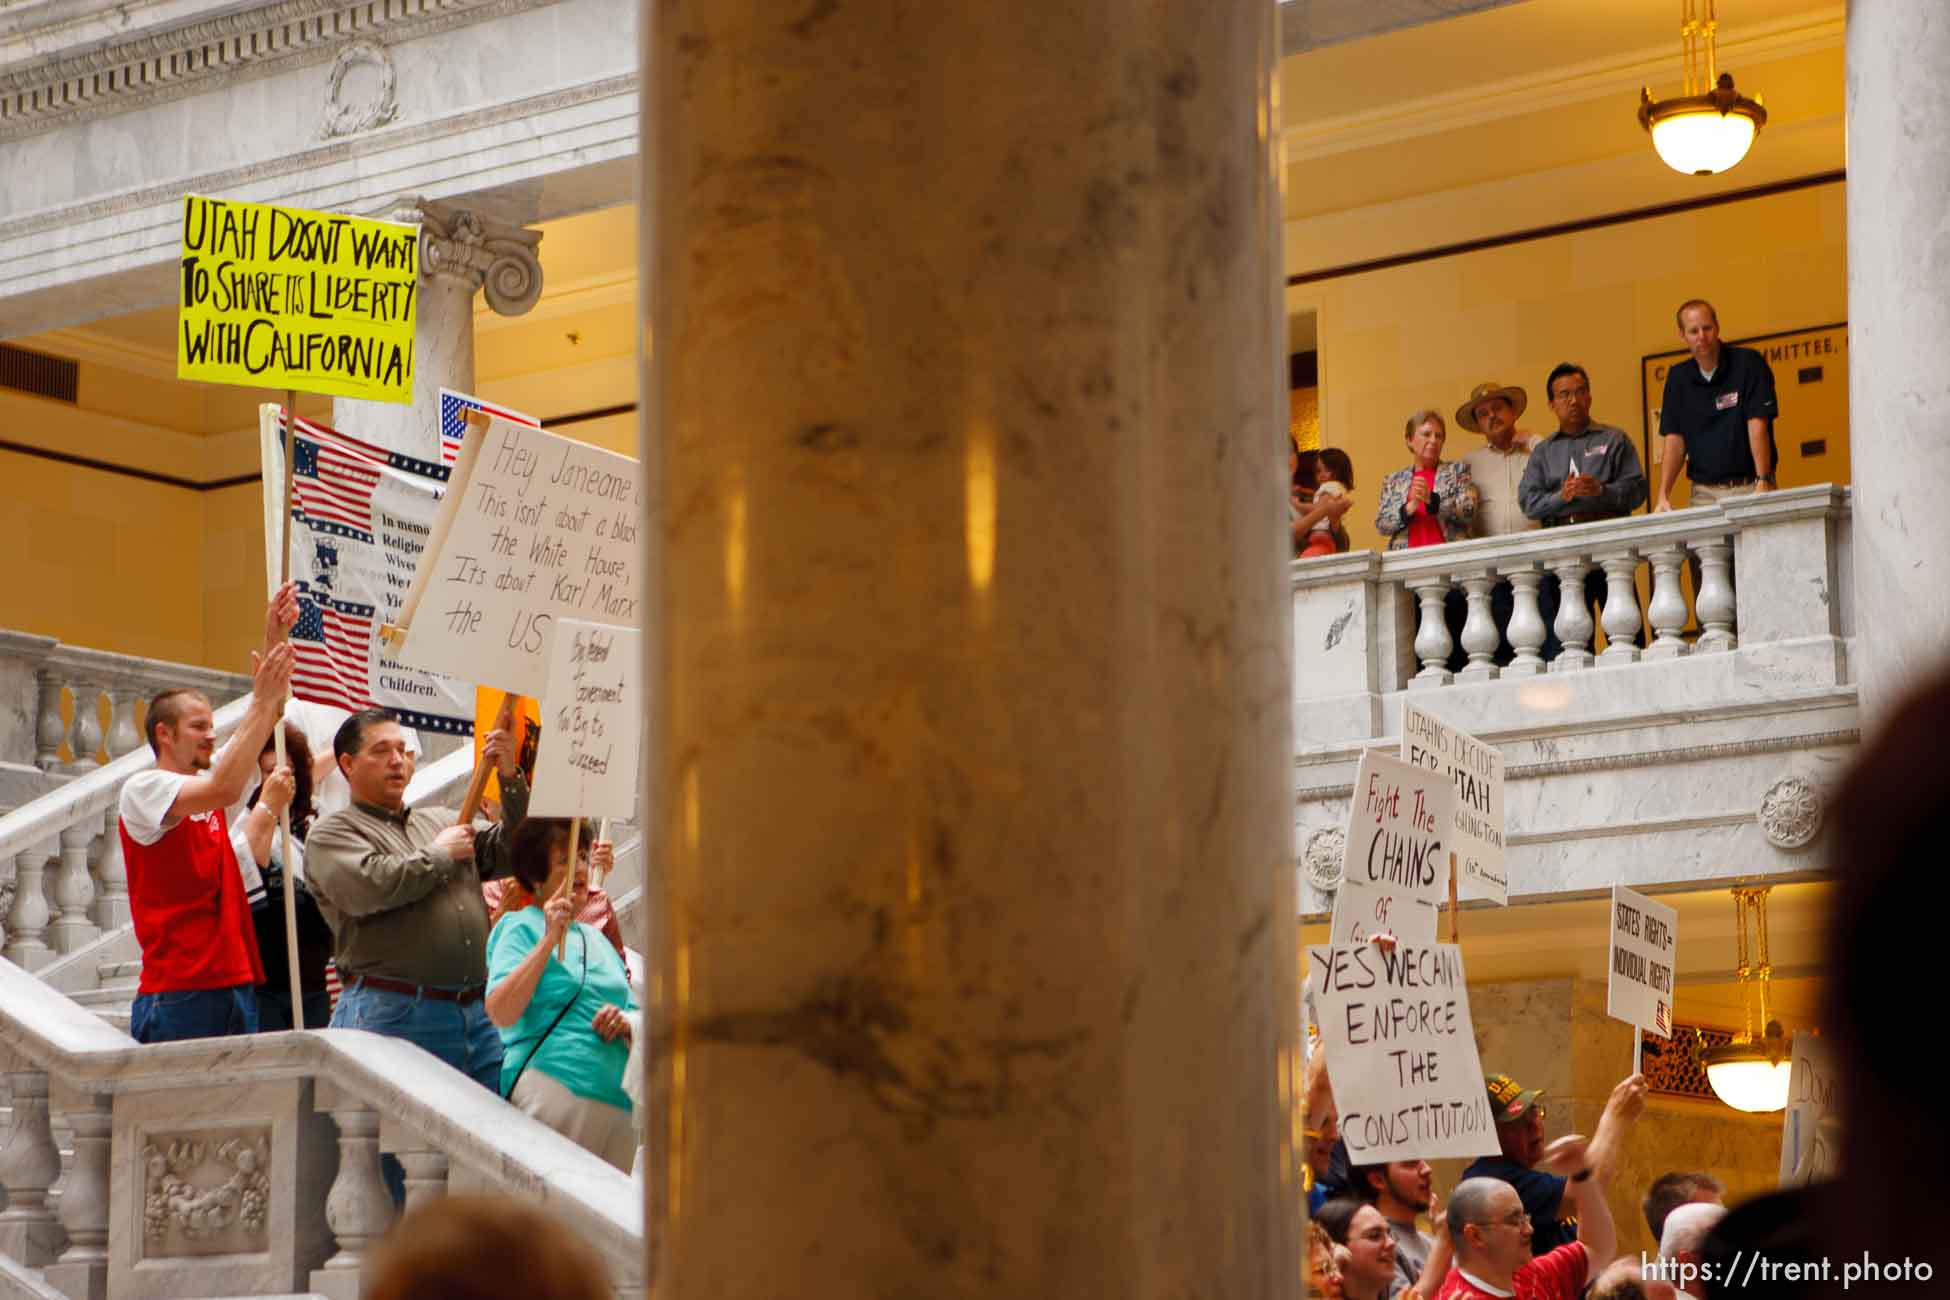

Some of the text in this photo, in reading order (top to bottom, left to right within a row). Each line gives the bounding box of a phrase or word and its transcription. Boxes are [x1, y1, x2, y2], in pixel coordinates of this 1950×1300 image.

[184, 198, 259, 261] UTAH
[351, 227, 417, 274] WANT
[182, 256, 209, 308] TO
[213, 261, 281, 315] SHARE
[309, 271, 416, 322] LIBERTY
[184, 319, 241, 365] WITH
[493, 429, 537, 497] Hey
[382, 513, 432, 537] In memo
[478, 482, 507, 518] This
[555, 504, 591, 534] about
[491, 526, 631, 586] the White House,
[446, 600, 482, 635] the
[496, 567, 536, 594] about
[550, 574, 591, 609] Karl
[592, 584, 638, 619] Marx
[379, 675, 437, 697] Children.
[1406, 706, 1497, 778] UTAHNS DECIDE
[1367, 772, 1435, 833] Fight The
[1368, 828, 1441, 888] CHAINS
[1616, 901, 1641, 939] STATES
[1312, 946, 1375, 995] YES
[1613, 944, 1671, 995] INDIVIDUAL RIGHTS
[1346, 999, 1456, 1044] ENFORCE
[1389, 1050, 1440, 1088] THE
